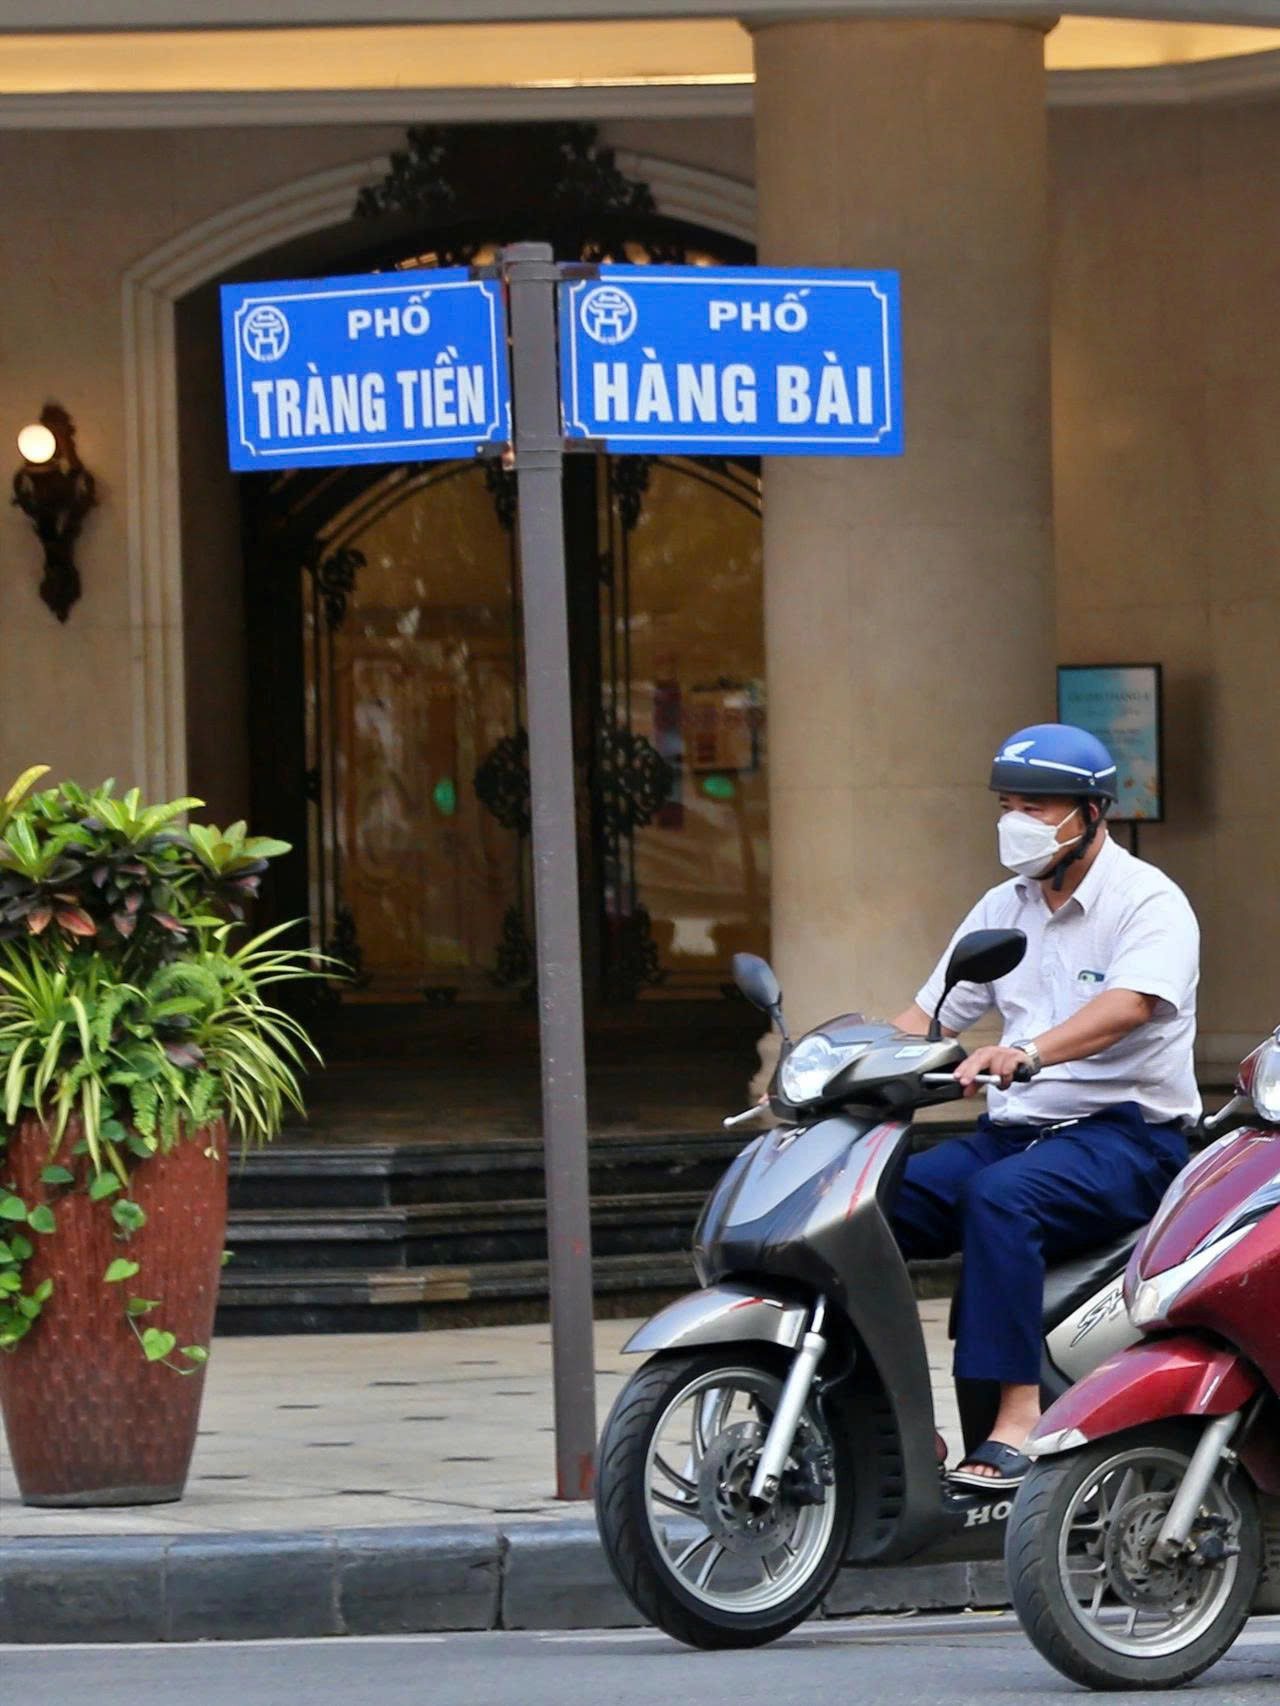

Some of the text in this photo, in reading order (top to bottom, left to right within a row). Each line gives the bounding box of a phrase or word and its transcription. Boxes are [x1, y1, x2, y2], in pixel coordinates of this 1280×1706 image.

[348, 290, 431, 339] PHỐ
[709, 289, 809, 332] PHỐ
[251, 345, 486, 439] TRÀNG TIỀN
[593, 347, 873, 424] HÀNG BÀI
